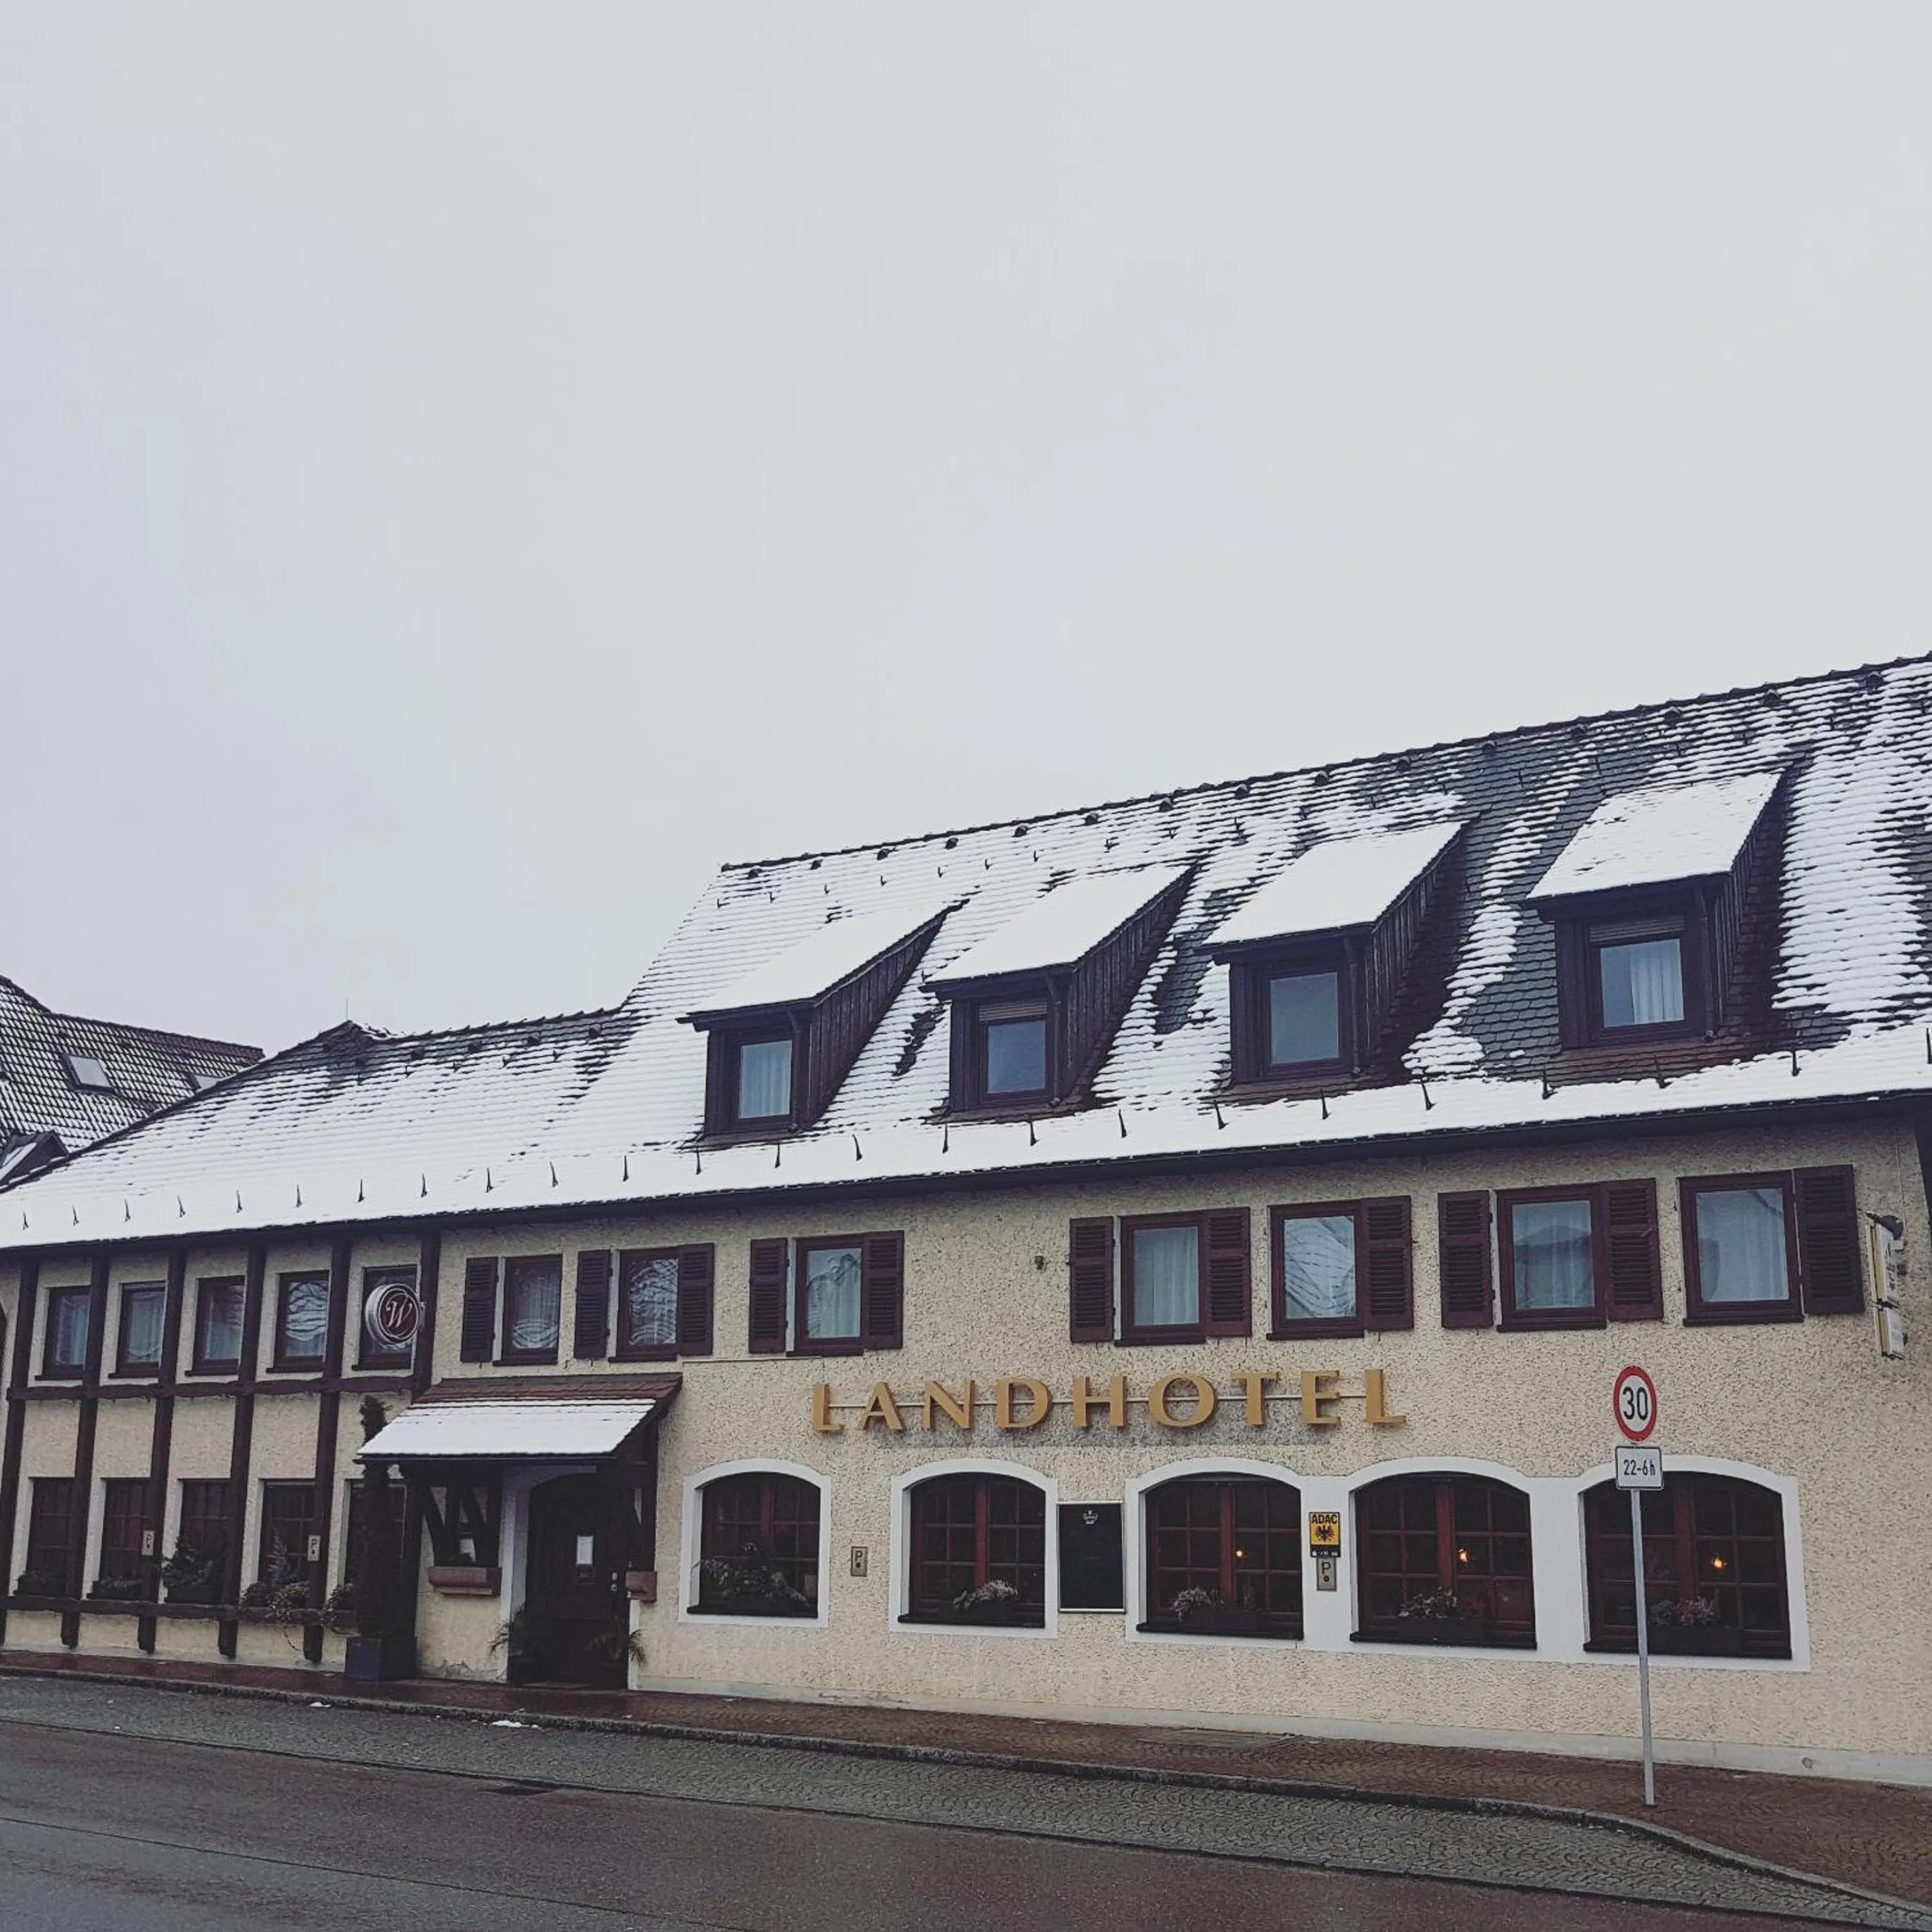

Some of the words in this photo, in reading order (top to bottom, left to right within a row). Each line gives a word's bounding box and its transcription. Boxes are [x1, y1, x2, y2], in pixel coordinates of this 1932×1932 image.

[812, 1368, 1407, 1434] LANDHOTEL
[1622, 1386, 1648, 1421] 30
[1312, 1514, 1338, 1524] ADAC
[855, 1550, 863, 1562] P
[1321, 1561, 1331, 1574] P
